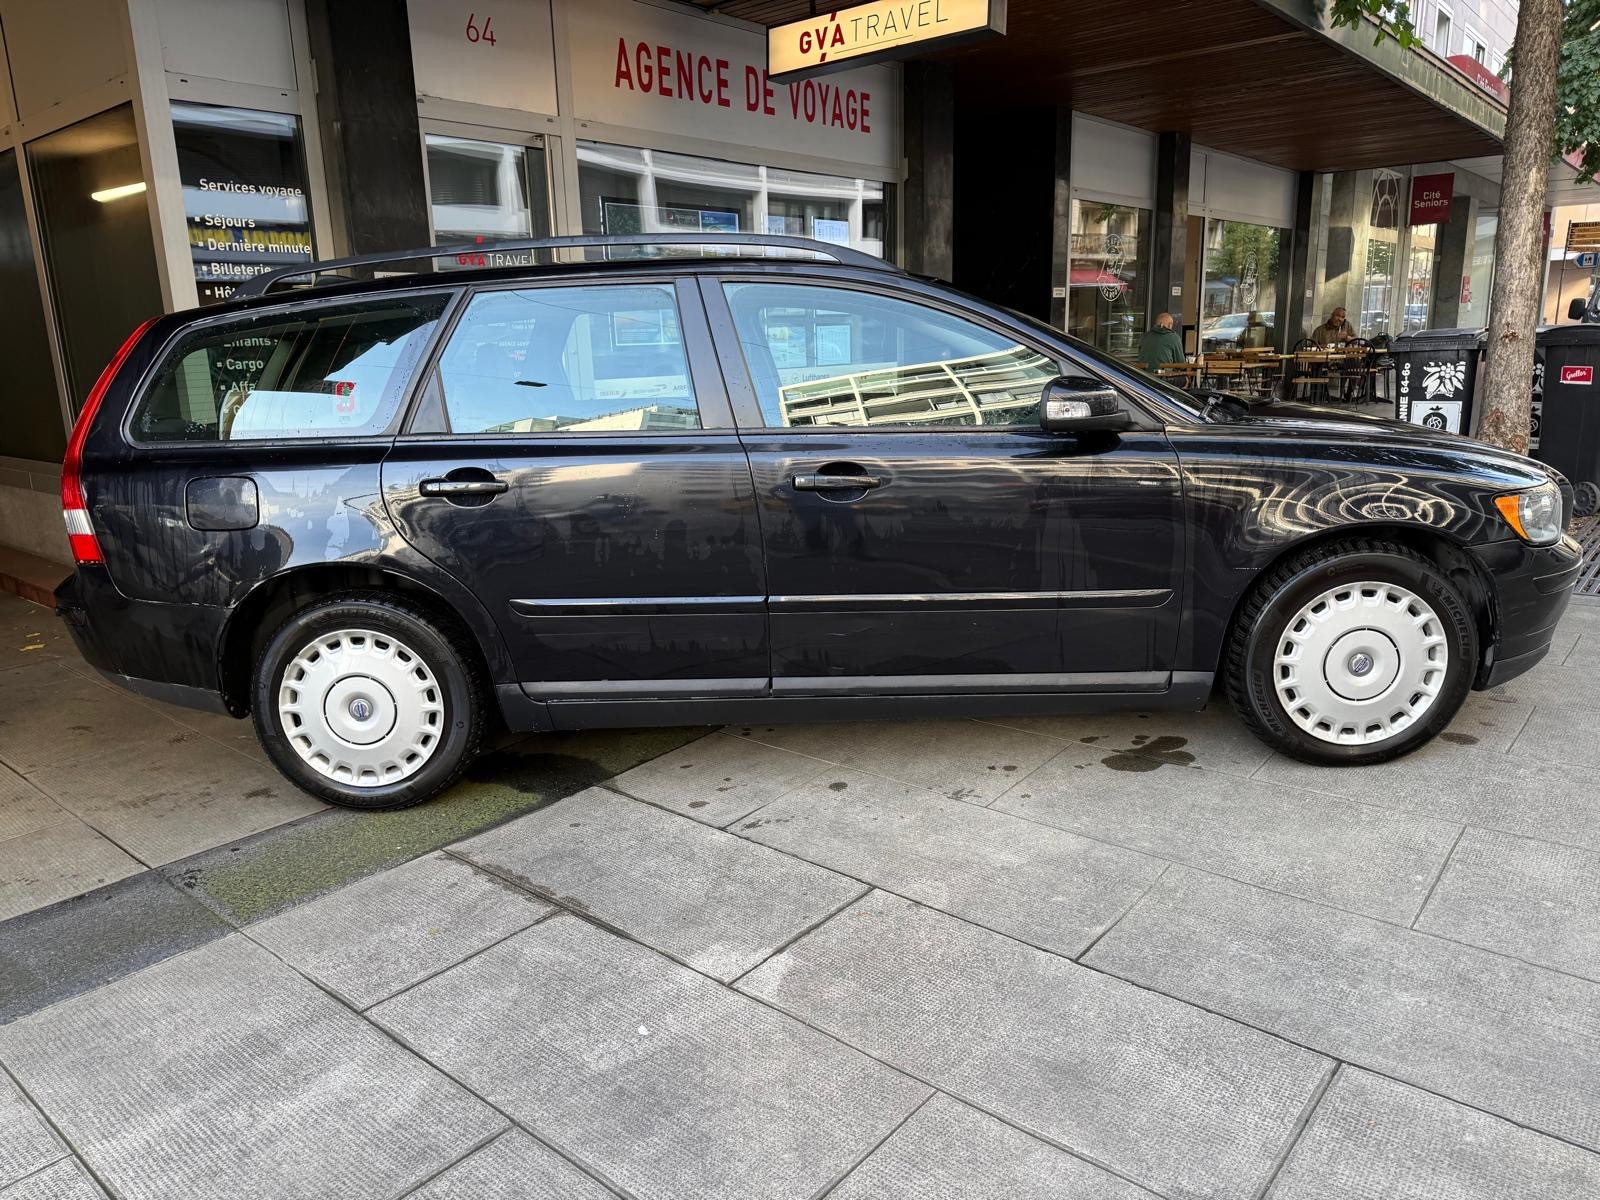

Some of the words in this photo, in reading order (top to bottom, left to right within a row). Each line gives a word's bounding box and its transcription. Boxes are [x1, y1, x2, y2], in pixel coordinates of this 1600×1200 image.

[466, 13, 497, 47] 64
[799, 23, 845, 54] GVA
[851, 0, 949, 43] TRAVEL
[614, 37, 731, 108] AGENCE
[745, 65, 776, 116] DE
[789, 79, 871, 133] VOYAGE
[200, 178, 256, 194] Services
[258, 185, 302, 198] voyage
[1423, 190, 1441, 200] Cité
[1414, 199, 1449, 209] Seniors
[204, 213, 256, 229] Séjours
[207, 238, 265, 252] Dernière
[268, 243, 311, 253] minute
[211, 262, 272, 275] Billeterie
[226, 358, 264, 372] Cargo
